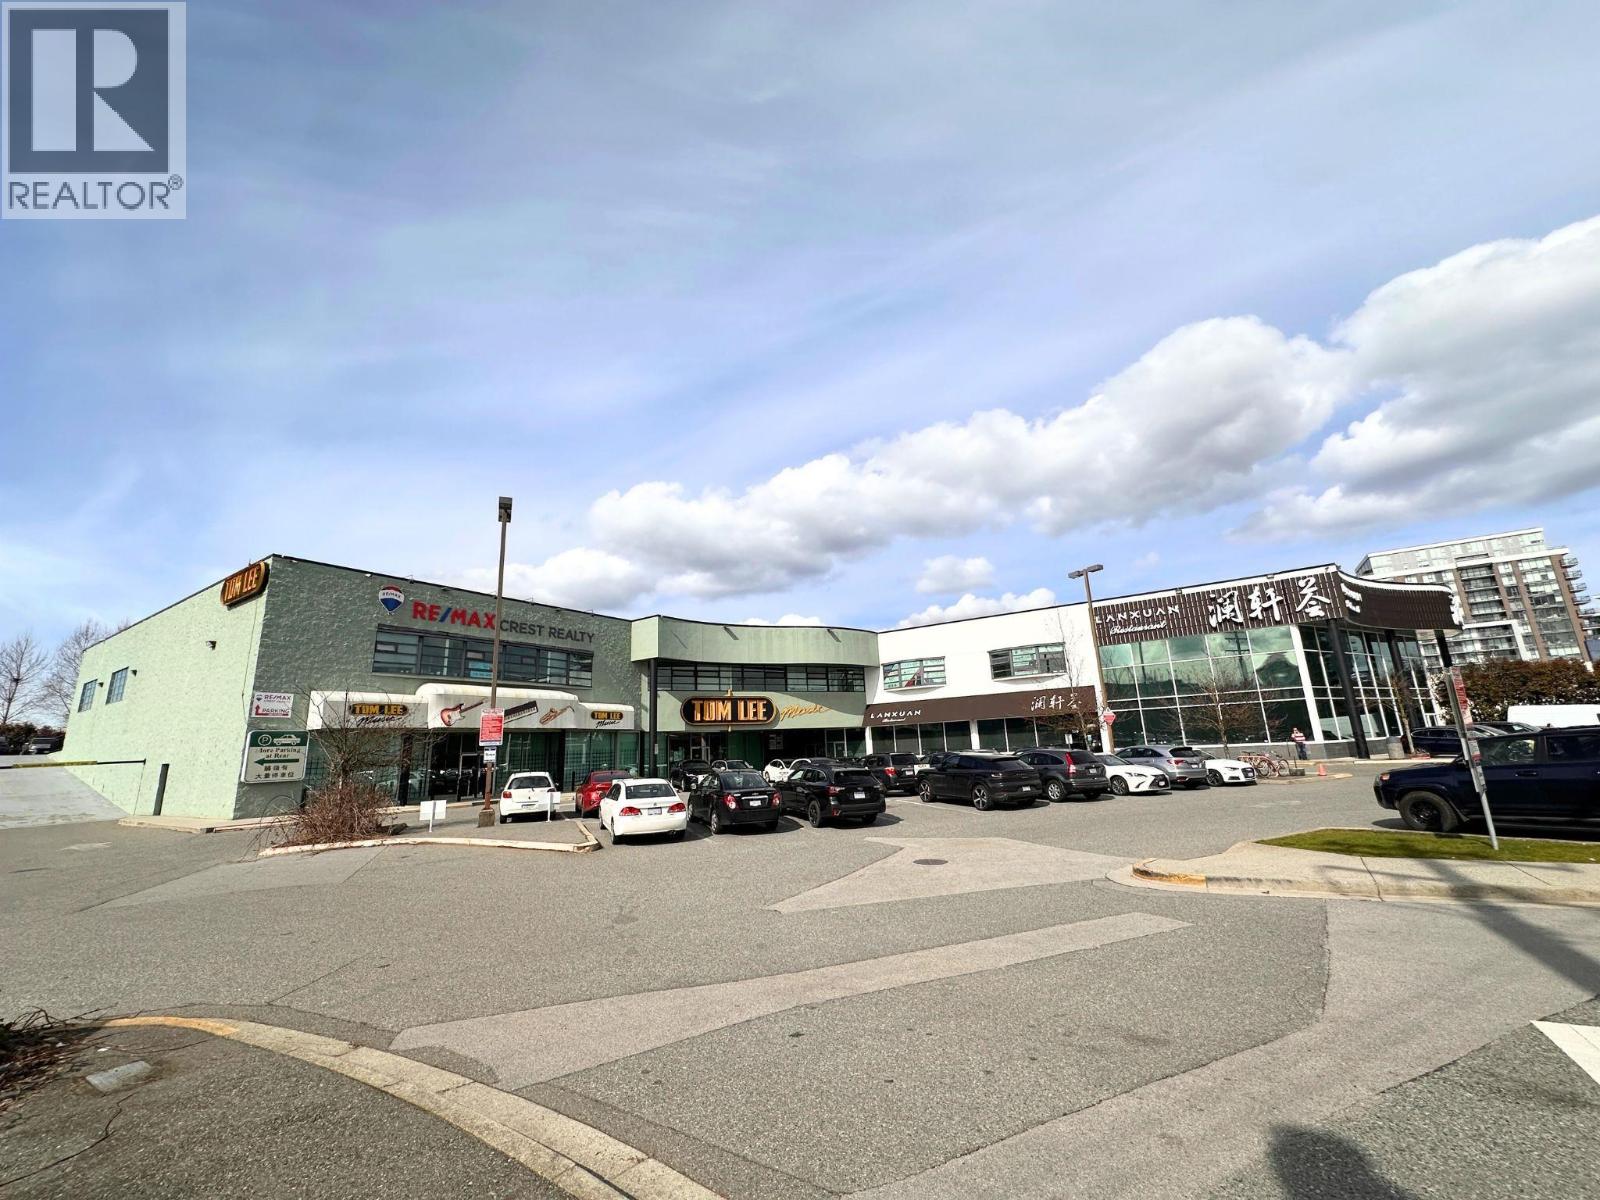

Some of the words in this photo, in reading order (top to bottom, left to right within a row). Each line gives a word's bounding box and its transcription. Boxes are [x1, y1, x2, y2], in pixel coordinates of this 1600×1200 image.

[224, 574, 243, 602] TOM
[243, 567, 258, 592] LEE
[412, 600, 496, 631] RE/MAX
[500, 619, 545, 637] CREST
[549, 626, 595, 643] REALTY
[1095, 604, 1180, 624] LANXUAN
[1110, 620, 1167, 635] Restaurant
[355, 704, 380, 715] TOM
[384, 704, 404, 715] LEE
[594, 711, 608, 720] TOM
[610, 711, 621, 720] LEE
[692, 700, 732, 721] TOM
[737, 700, 768, 721] LEE
[870, 710, 921, 719] LANXUAN
